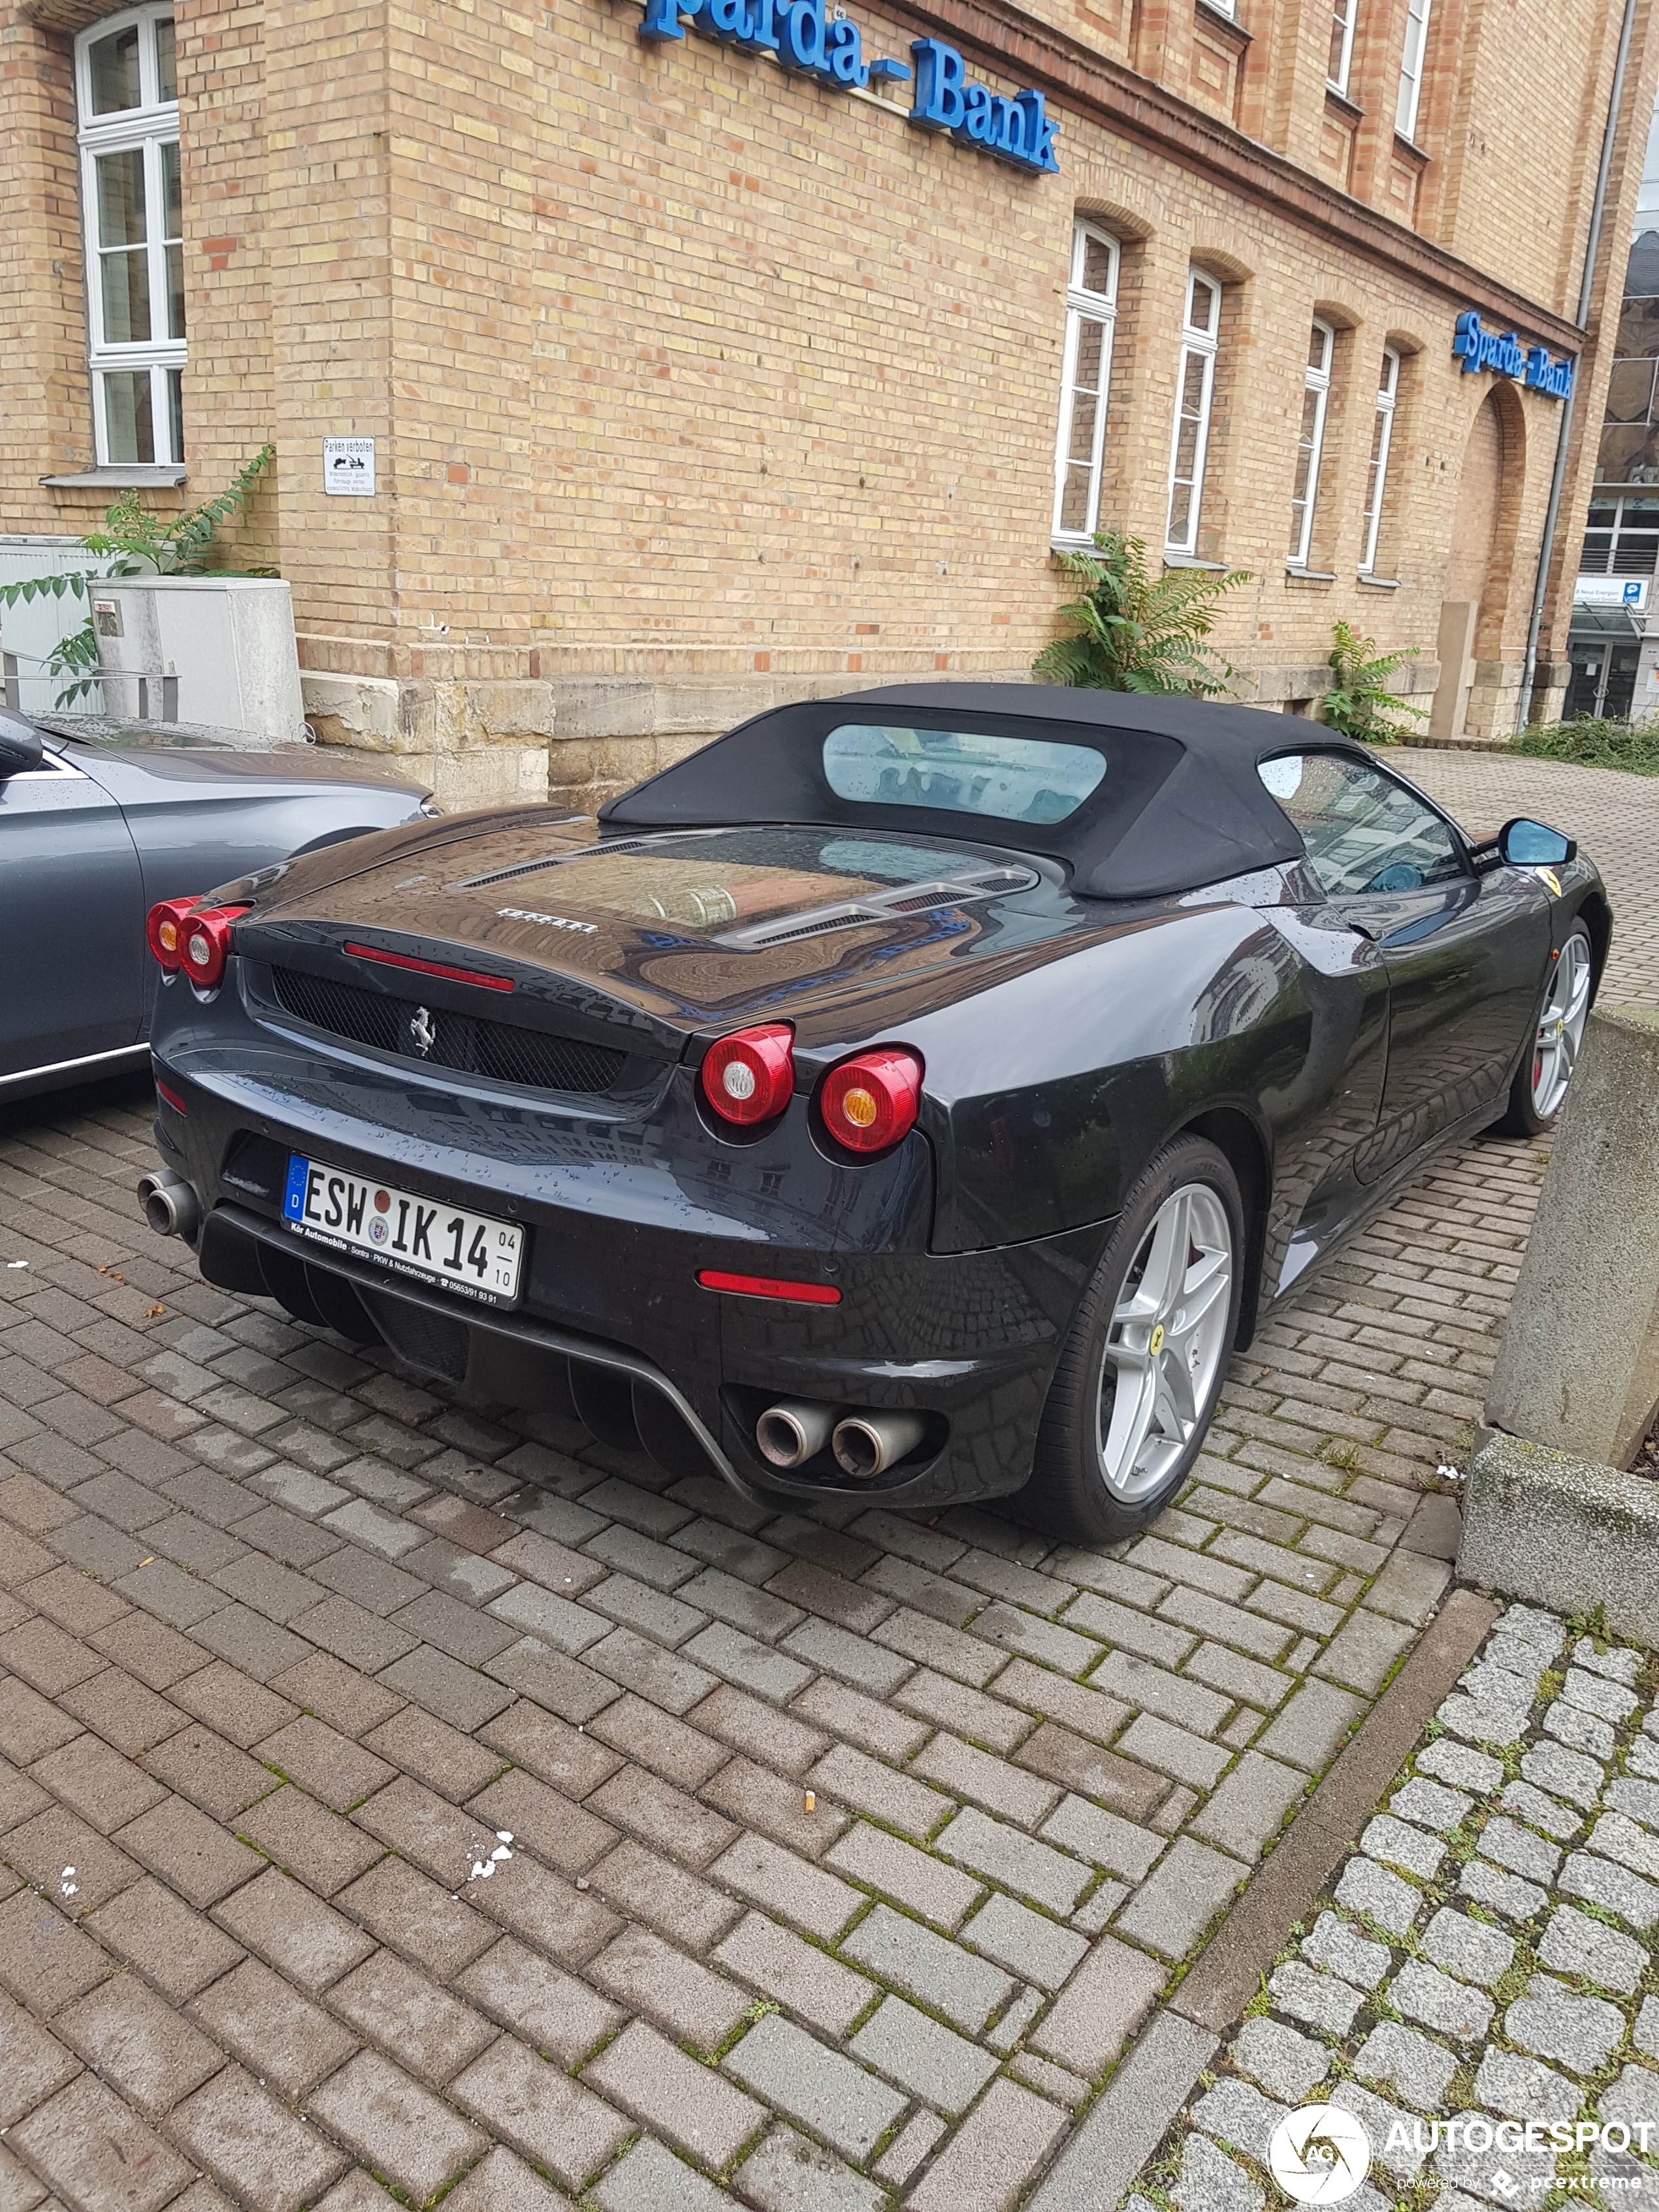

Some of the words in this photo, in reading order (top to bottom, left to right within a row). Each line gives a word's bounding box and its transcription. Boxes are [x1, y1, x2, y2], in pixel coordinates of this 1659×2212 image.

[1454, 311, 1573, 400] Sparda-Bank
[325, 440, 345, 452] Parken
[346, 440, 373, 452] verboten
[291, 1193, 299, 1208] D
[304, 1169, 367, 1235] ESW
[392, 1200, 437, 1260] IK
[443, 1217, 488, 1278] 14
[499, 1232, 515, 1250] 04
[291, 1223, 304, 1234] Kör
[305, 1228, 347, 1250] Automobile
[351, 1246, 370, 1258] Sontra
[373, 1253, 389, 1265] PKW
[395, 1262, 436, 1283] Nutzfahrzeuge
[449, 1281, 477, 1298] 05653/91
[479, 1290, 487, 1301] 93
[488, 1294, 497, 1304] 91
[496, 1268, 510, 1287] 10
